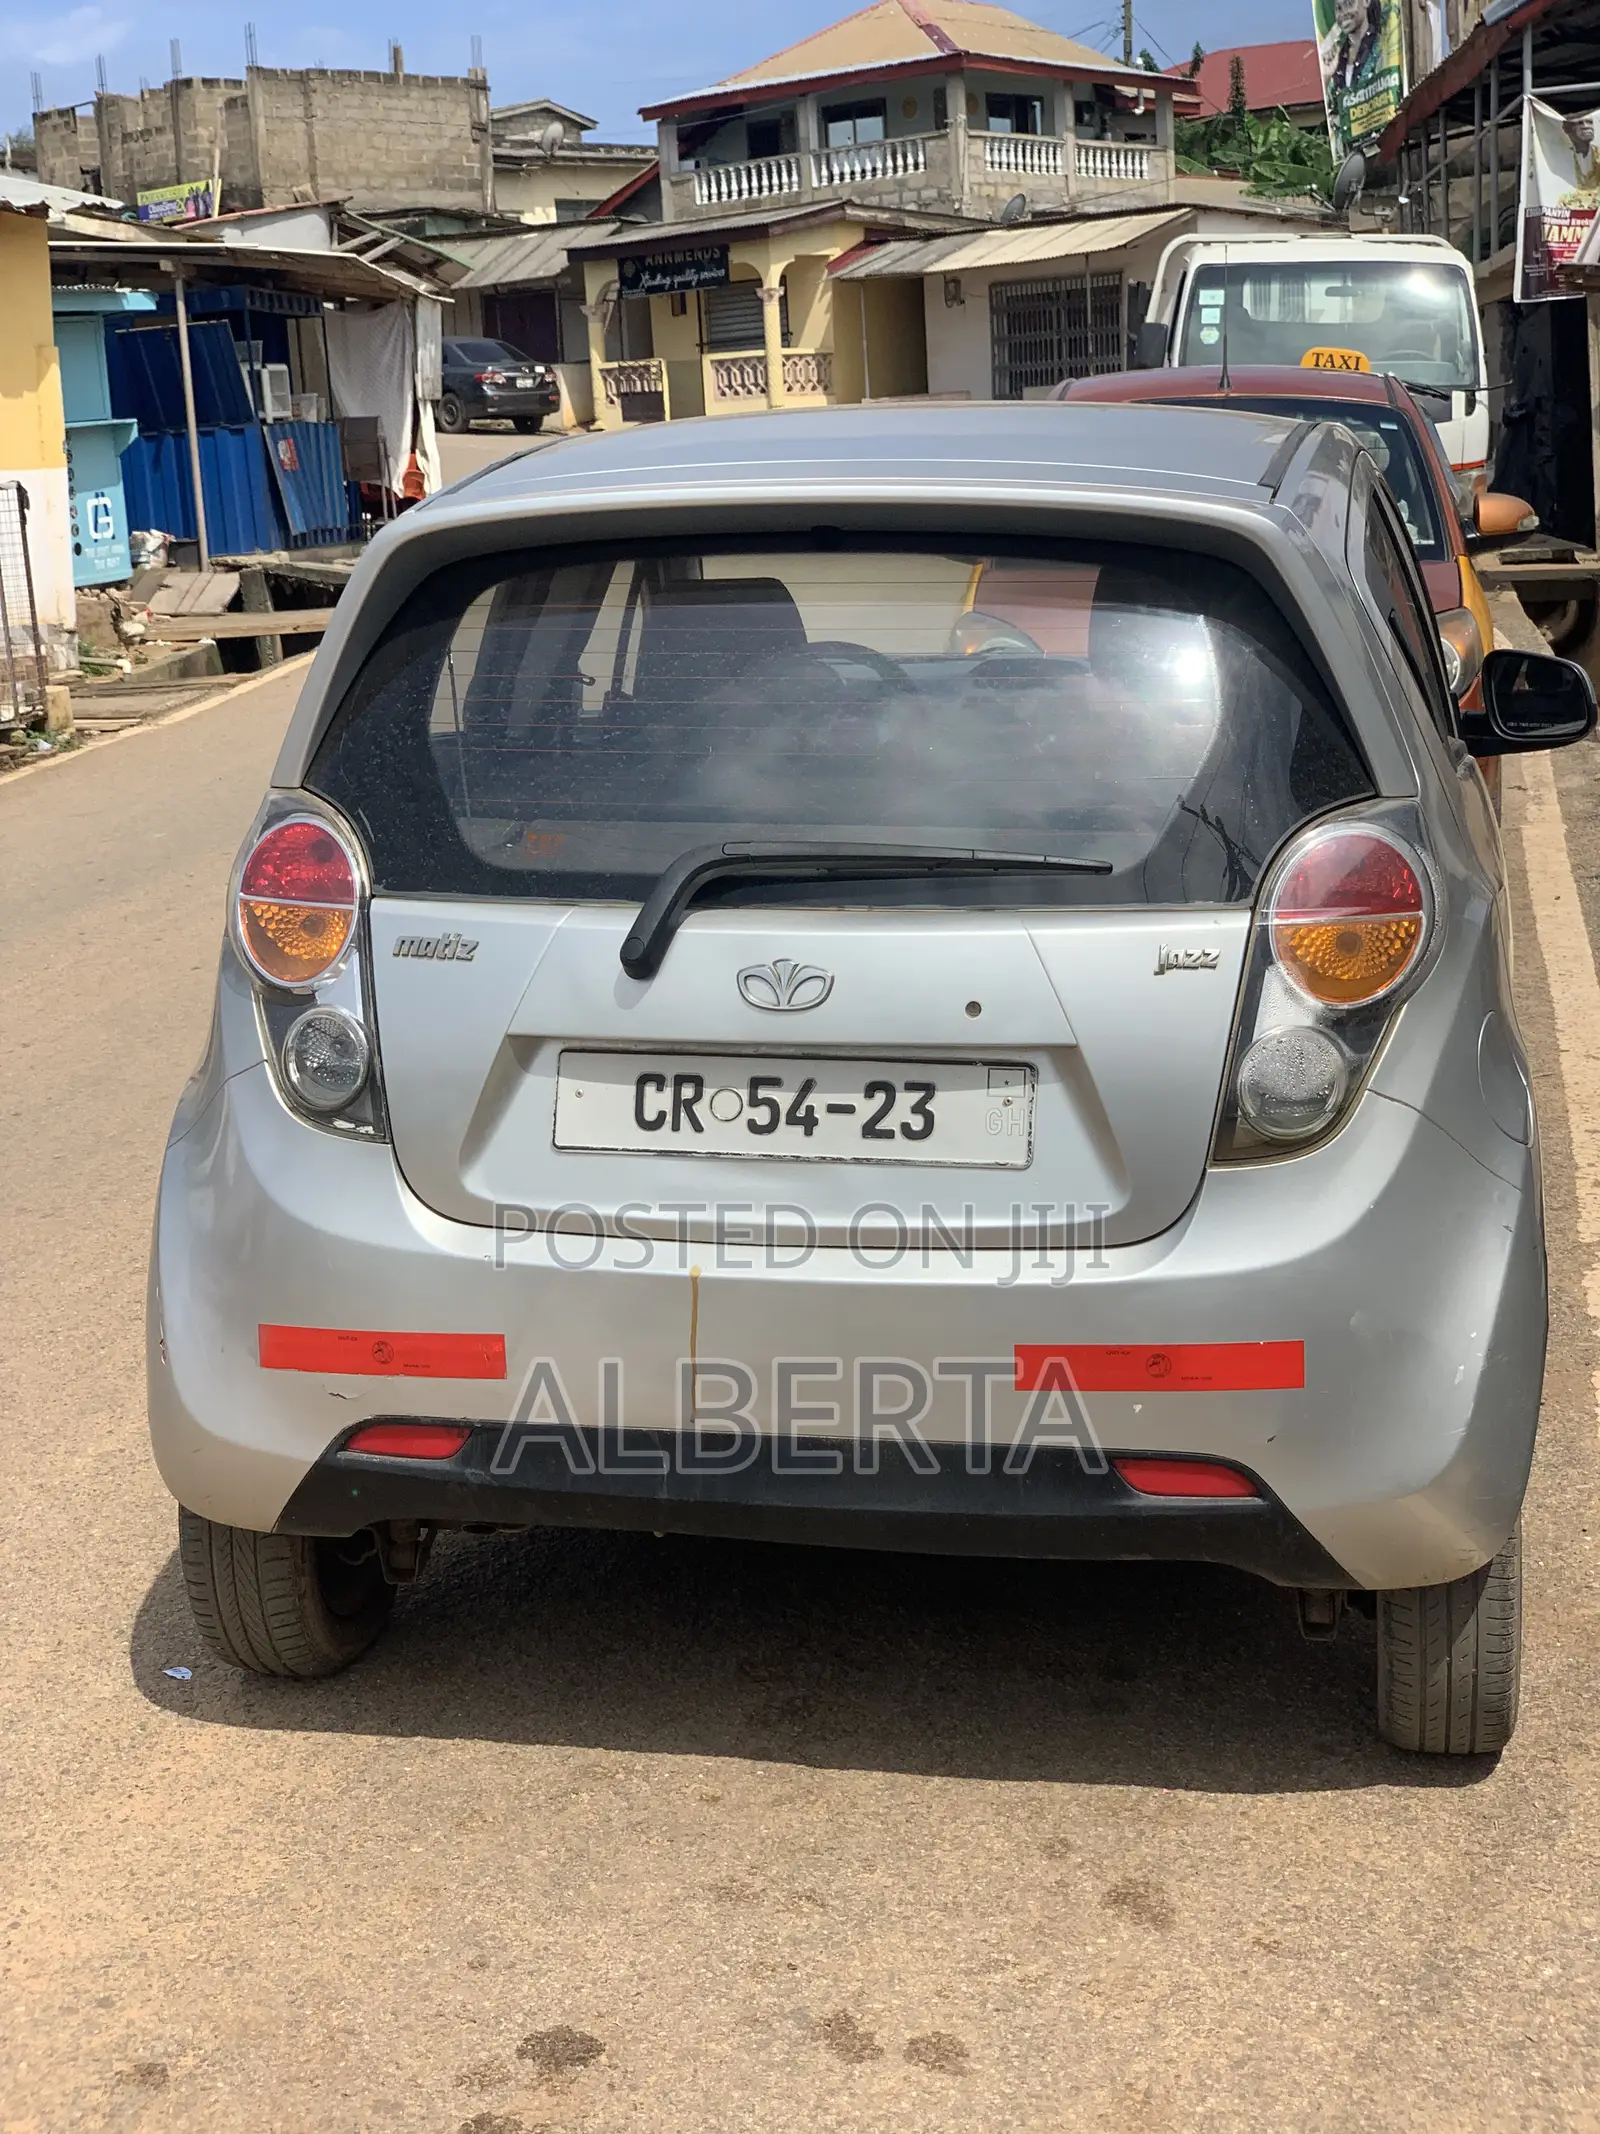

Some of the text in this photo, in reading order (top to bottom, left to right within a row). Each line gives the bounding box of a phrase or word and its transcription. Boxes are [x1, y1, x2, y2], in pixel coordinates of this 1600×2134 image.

[1311, 352, 1361, 371] TAXI
[392, 932, 479, 961] matiz
[1153, 943, 1221, 976] jazz
[634, 1072, 937, 1141] CR 54-23
[985, 1107, 1025, 1137] GH
